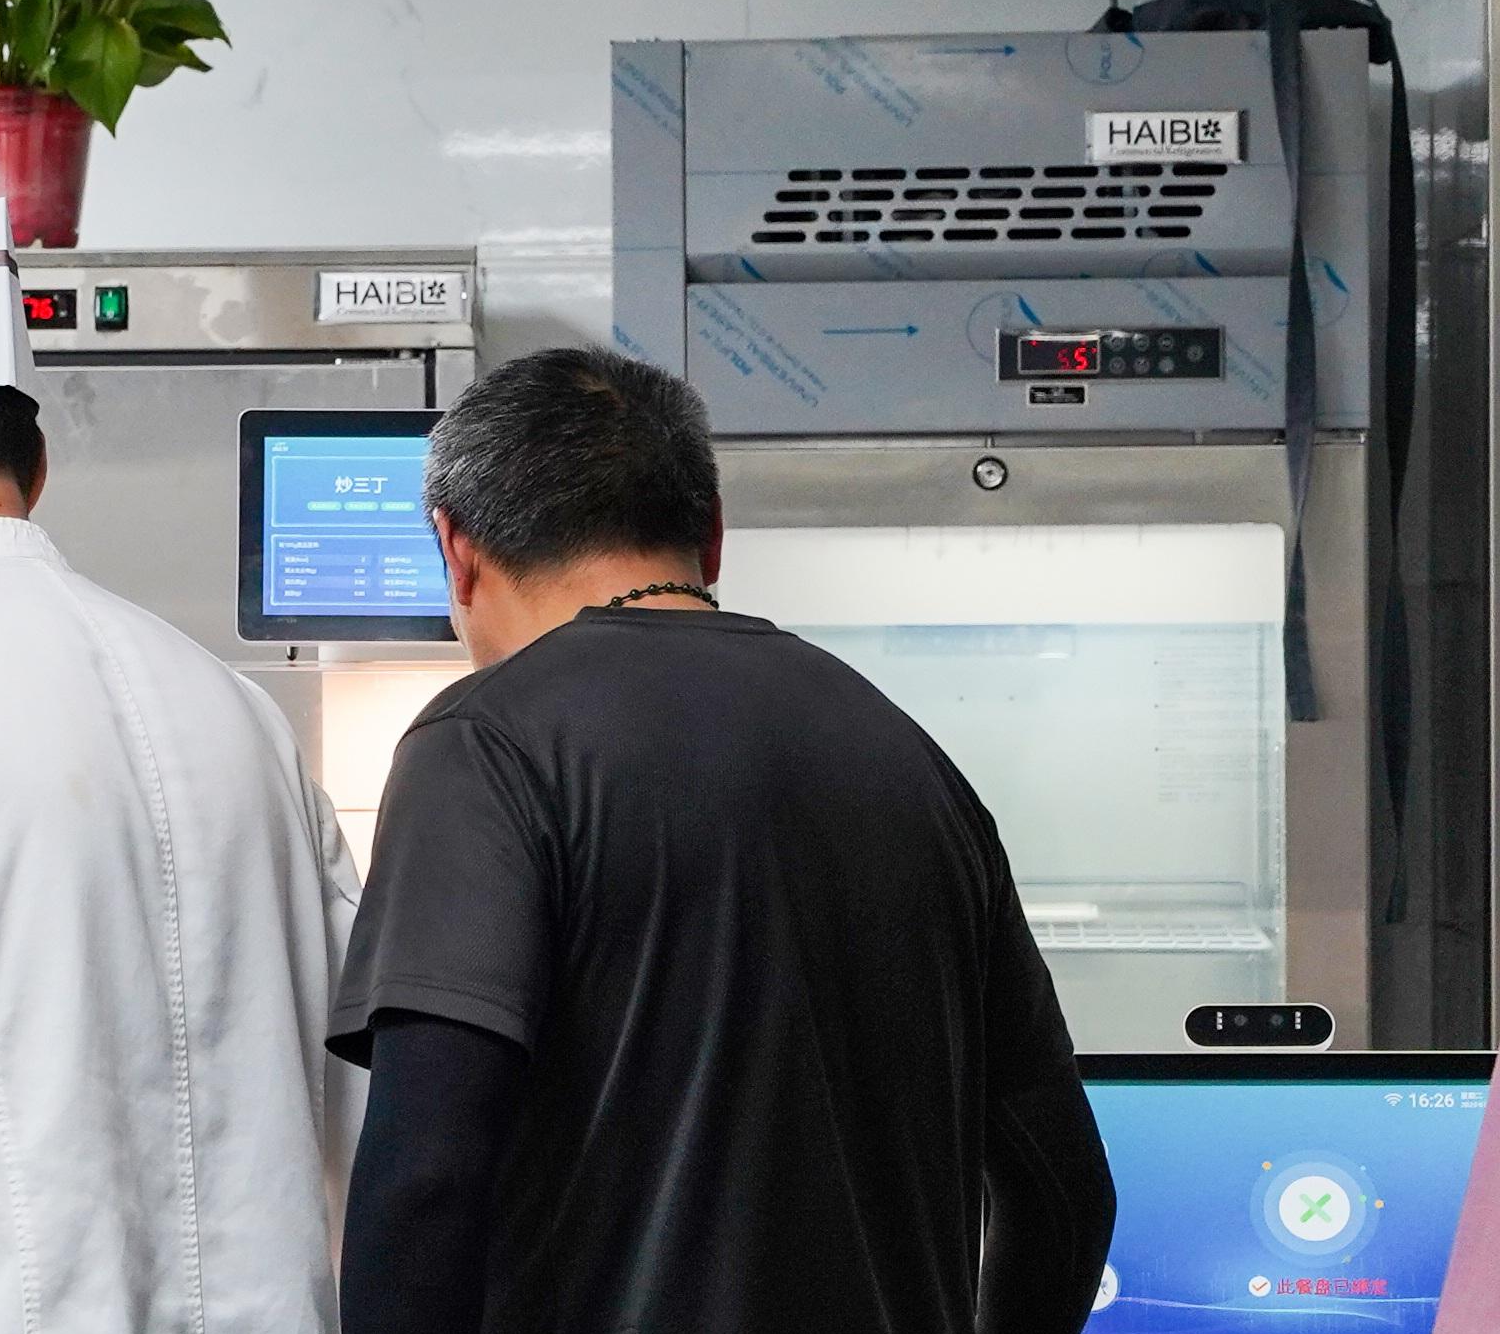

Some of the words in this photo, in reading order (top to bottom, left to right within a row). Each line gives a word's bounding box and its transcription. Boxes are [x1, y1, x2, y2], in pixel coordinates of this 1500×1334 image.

[335, 476, 388, 494] 炒三丁
[1409, 1093, 1454, 1108] 16:26
